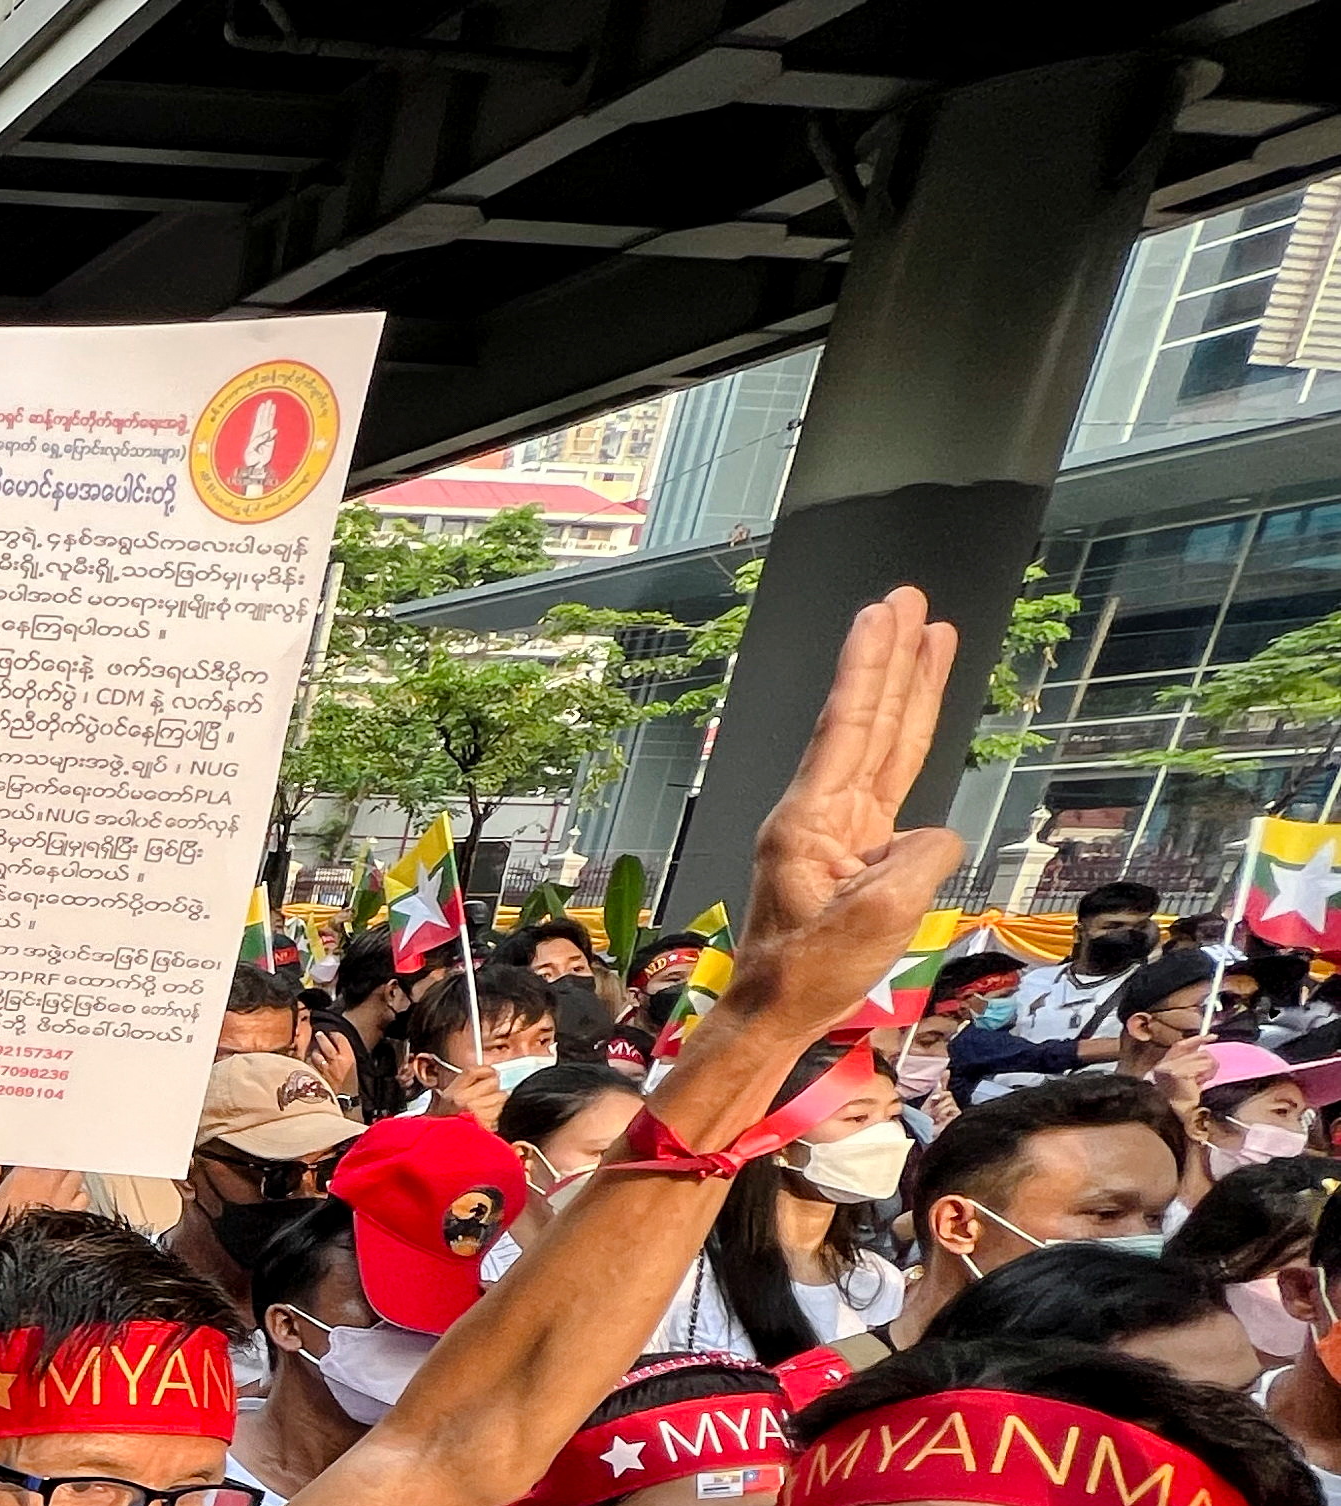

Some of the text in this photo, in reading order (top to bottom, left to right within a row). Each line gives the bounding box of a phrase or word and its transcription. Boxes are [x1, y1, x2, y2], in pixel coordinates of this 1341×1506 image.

[95, 687, 144, 707] CDM
[189, 760, 239, 777] NUG
[658, 1407, 792, 1462] MYA
